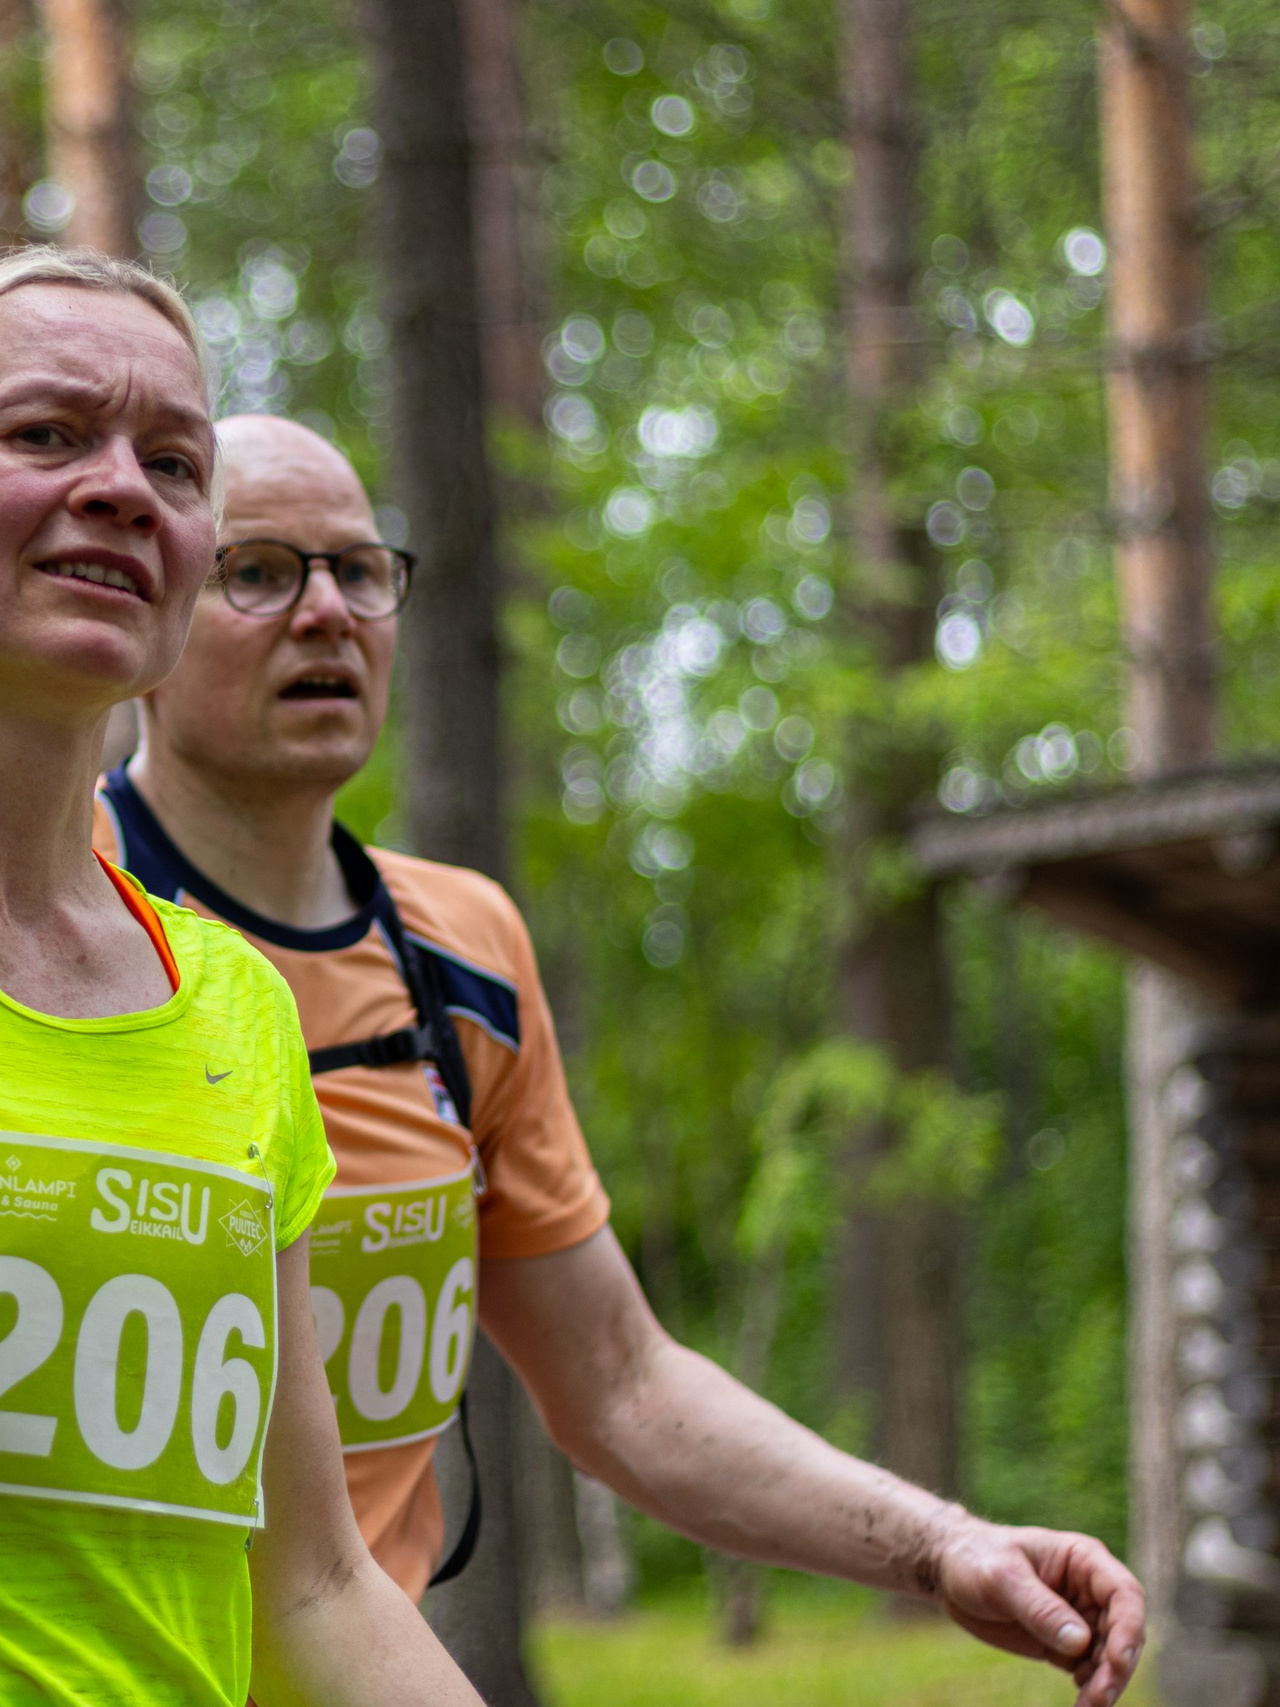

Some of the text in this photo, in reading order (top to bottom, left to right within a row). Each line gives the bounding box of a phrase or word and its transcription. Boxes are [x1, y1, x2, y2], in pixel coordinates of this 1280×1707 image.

[14, 1197, 58, 1211] Sauna
[90, 1167, 211, 1245] SISU
[361, 1194, 447, 1253] SISU
